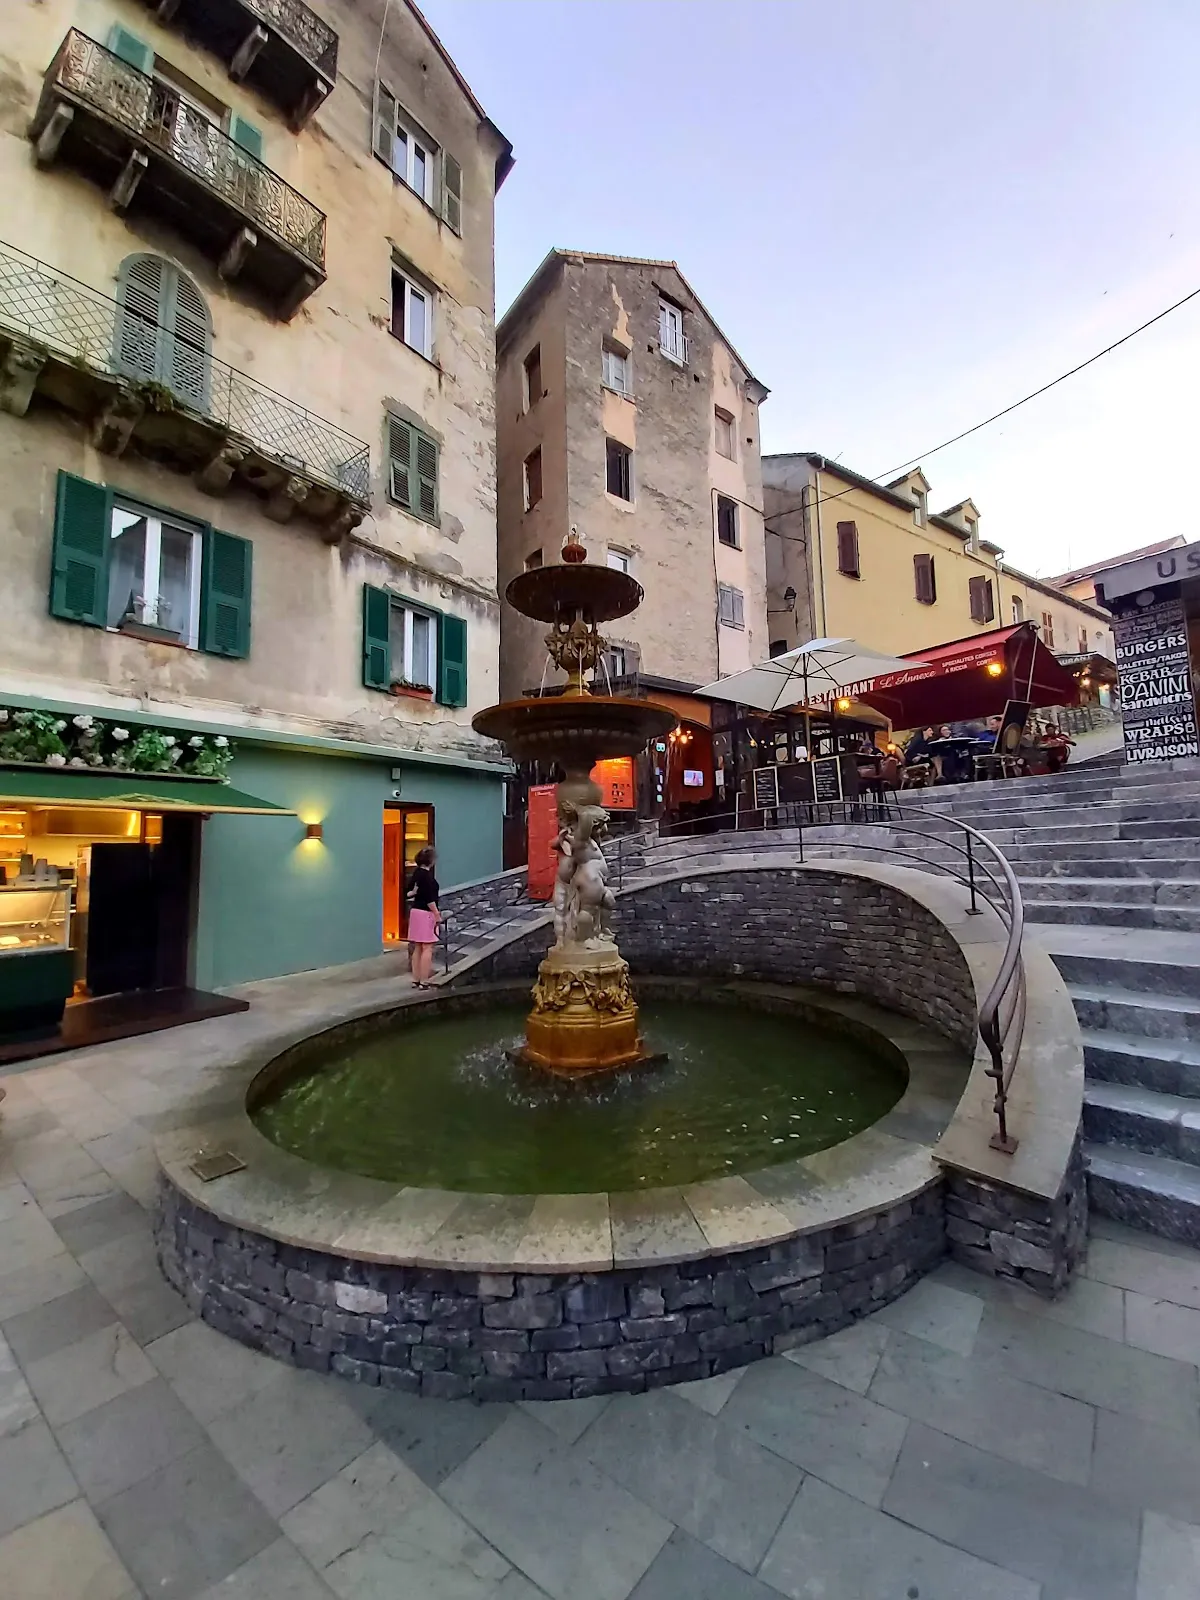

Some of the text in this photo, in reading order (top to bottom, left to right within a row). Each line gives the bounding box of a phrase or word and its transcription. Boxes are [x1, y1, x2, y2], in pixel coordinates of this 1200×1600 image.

[1116, 633, 1187, 659] BURGERS
[1120, 666, 1171, 686] KEBAB
[1121, 674, 1189, 702] PANINI
[1122, 700, 1194, 722] DESSERTS
[1125, 723, 1185, 740] WRAPS
[1126, 742, 1199, 761] LIVRAISON
